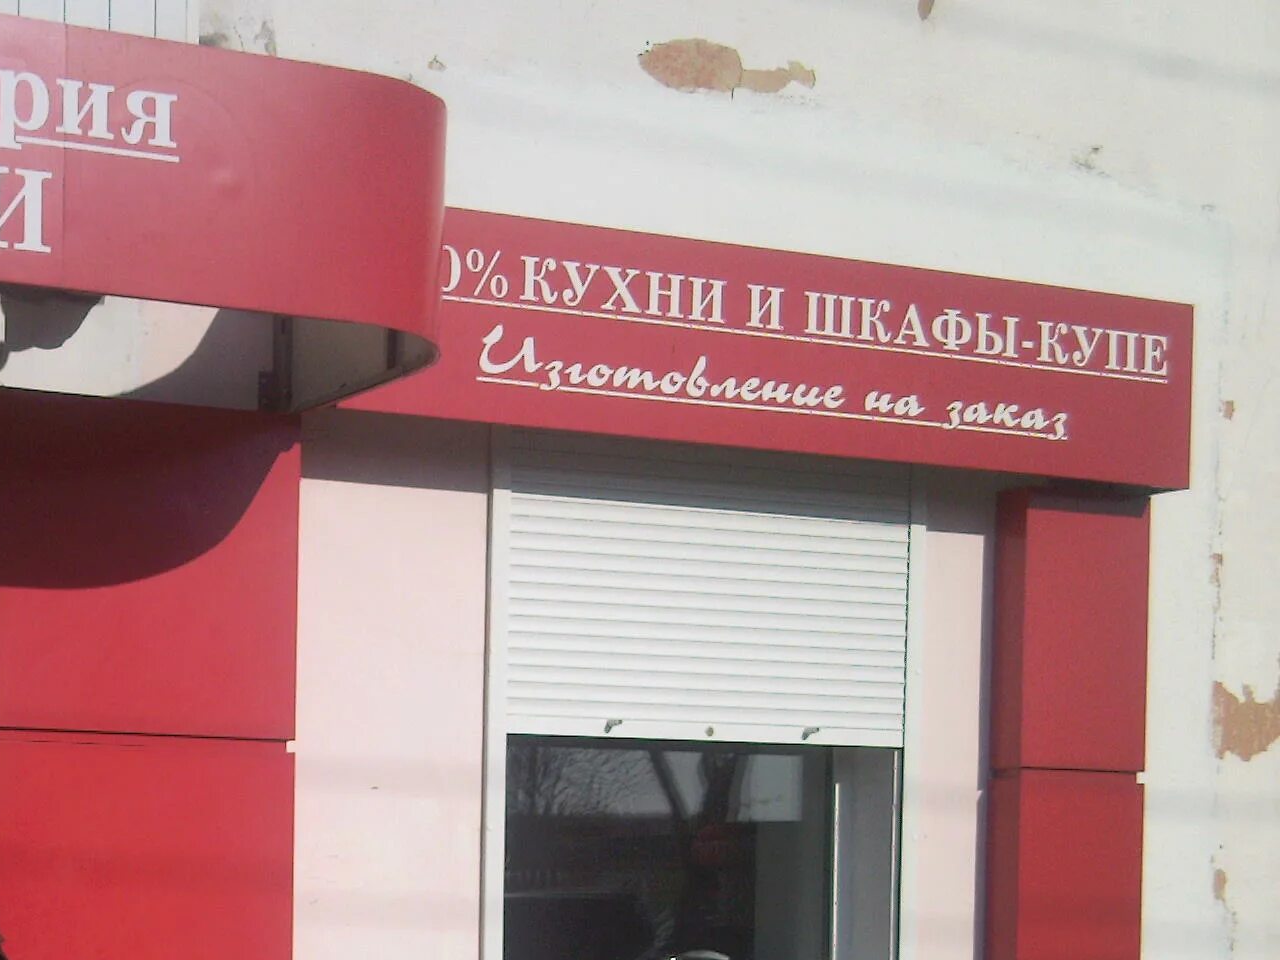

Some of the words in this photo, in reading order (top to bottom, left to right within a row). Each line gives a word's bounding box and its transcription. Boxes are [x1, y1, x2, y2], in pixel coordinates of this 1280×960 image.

[519, 254, 728, 324] КУХНИ
[745, 283, 785, 330] И
[803, 290, 1169, 377] ШКАФЫ-КУПЕ
[477, 323, 845, 408] Изготовление
[864, 389, 925, 417] на
[941, 399, 1070, 442] заказ
